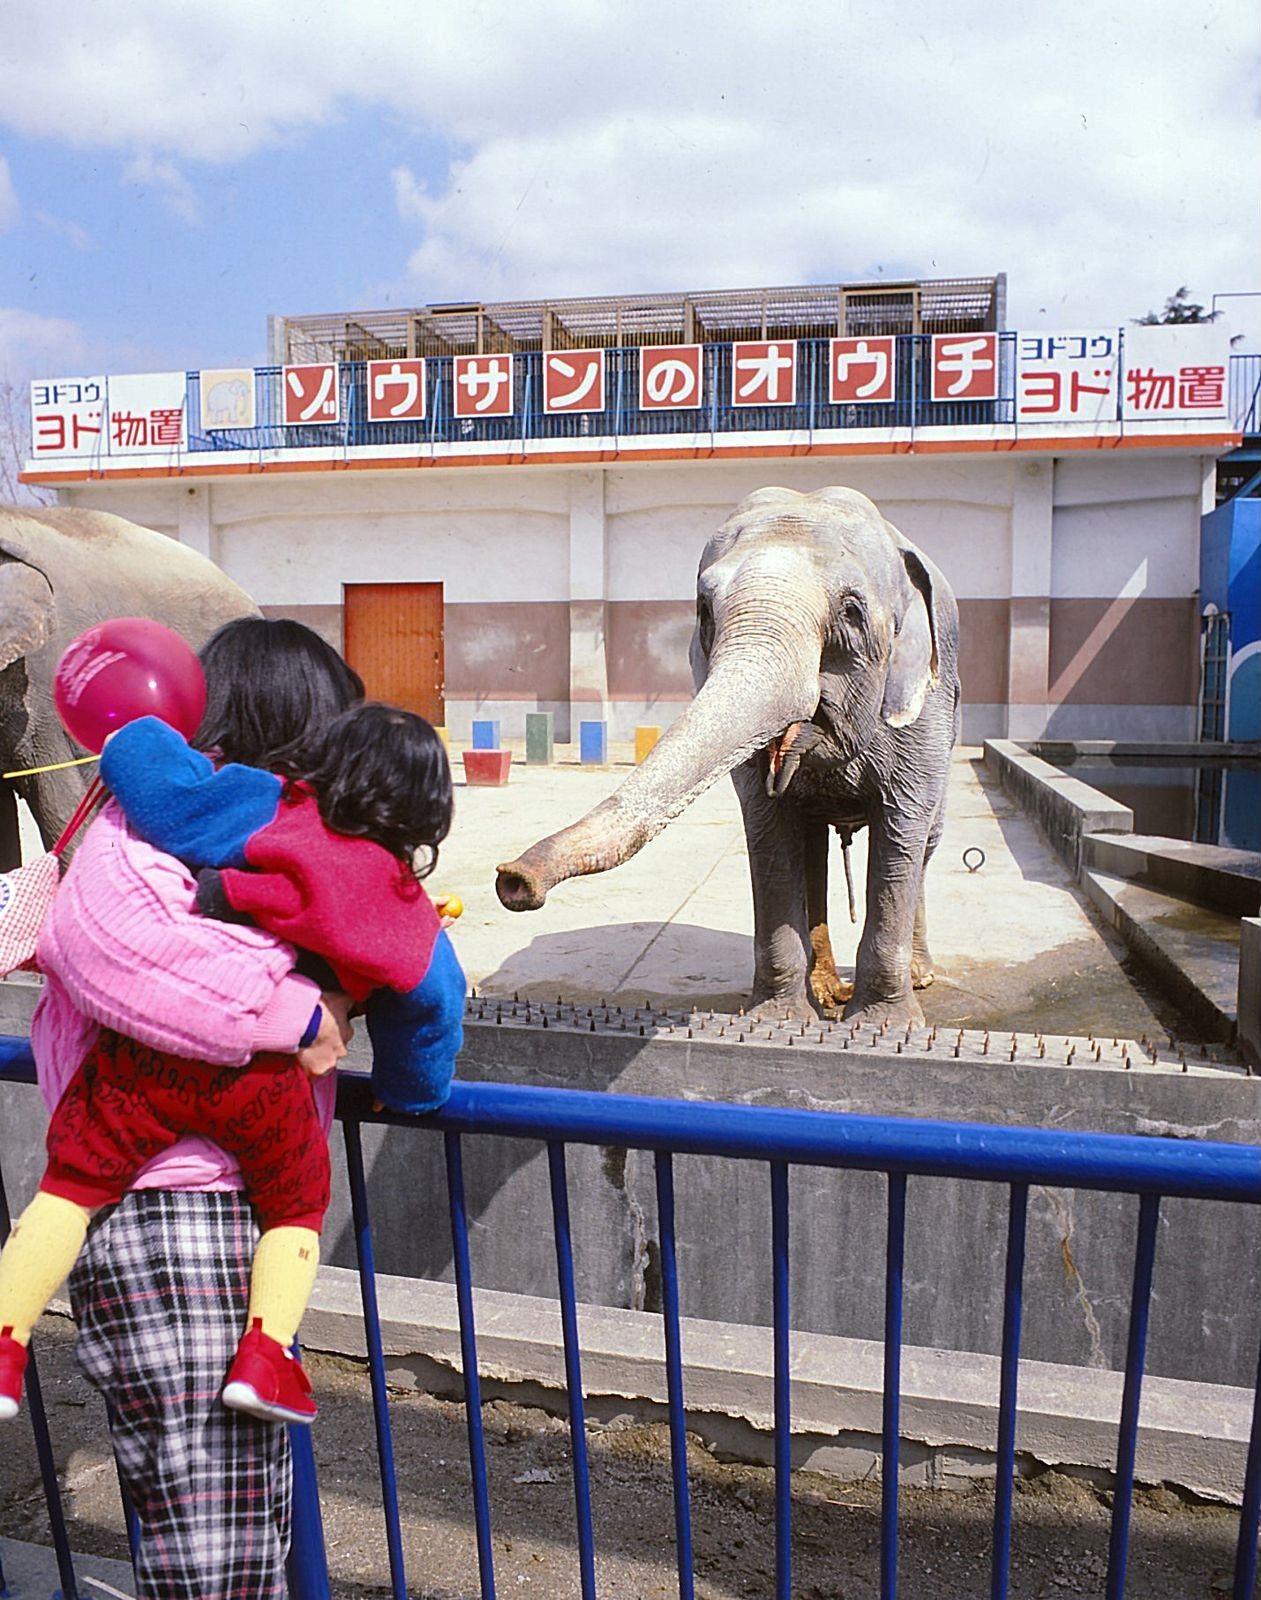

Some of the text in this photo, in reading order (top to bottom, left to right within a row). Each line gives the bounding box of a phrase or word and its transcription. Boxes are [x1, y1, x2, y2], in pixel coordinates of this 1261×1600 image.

[1021, 336, 1112, 360] ヨドコウ
[288, 338, 994, 421] ゾウサンのオウチ
[35, 383, 100, 406] ヨドコウ
